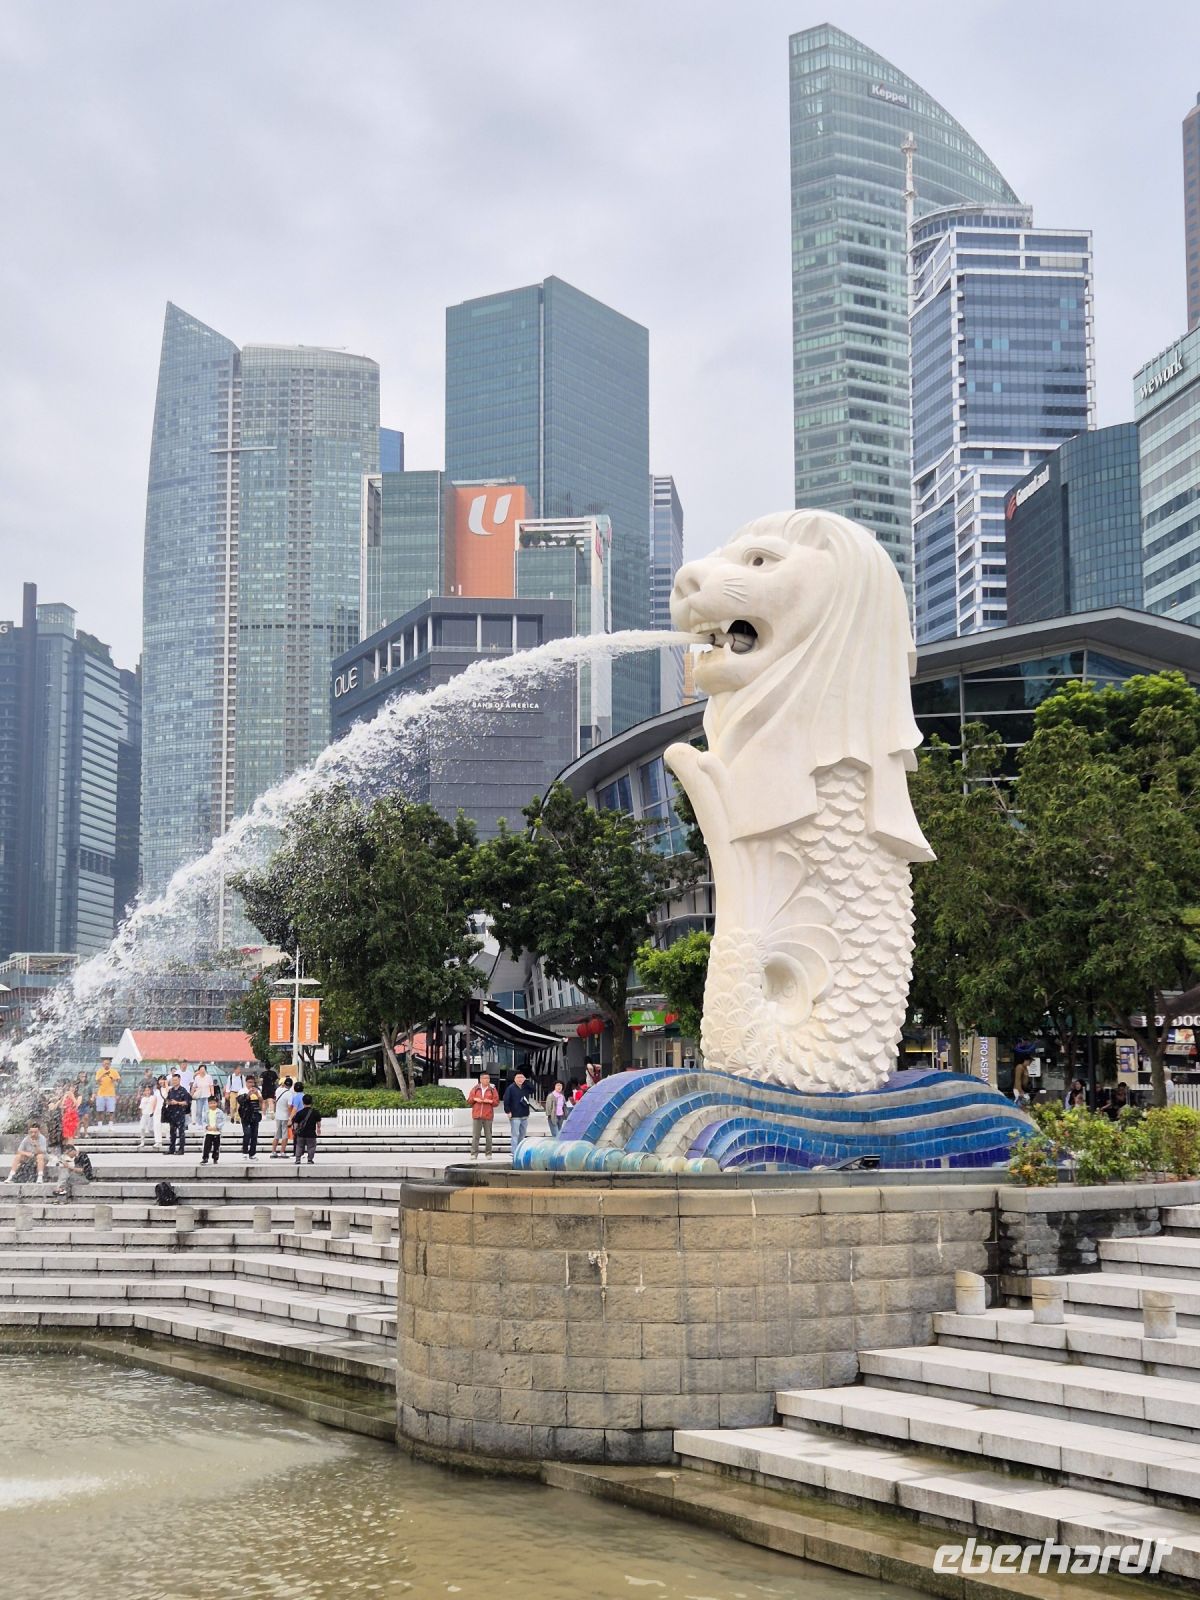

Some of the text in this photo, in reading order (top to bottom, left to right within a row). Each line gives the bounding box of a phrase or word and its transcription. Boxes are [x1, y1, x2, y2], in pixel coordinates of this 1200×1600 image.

[871, 84, 908, 104] Keppel
[1140, 350, 1184, 400] wework
[334, 666, 358, 698] OUE
[505, 702, 540, 710] AMERICA
